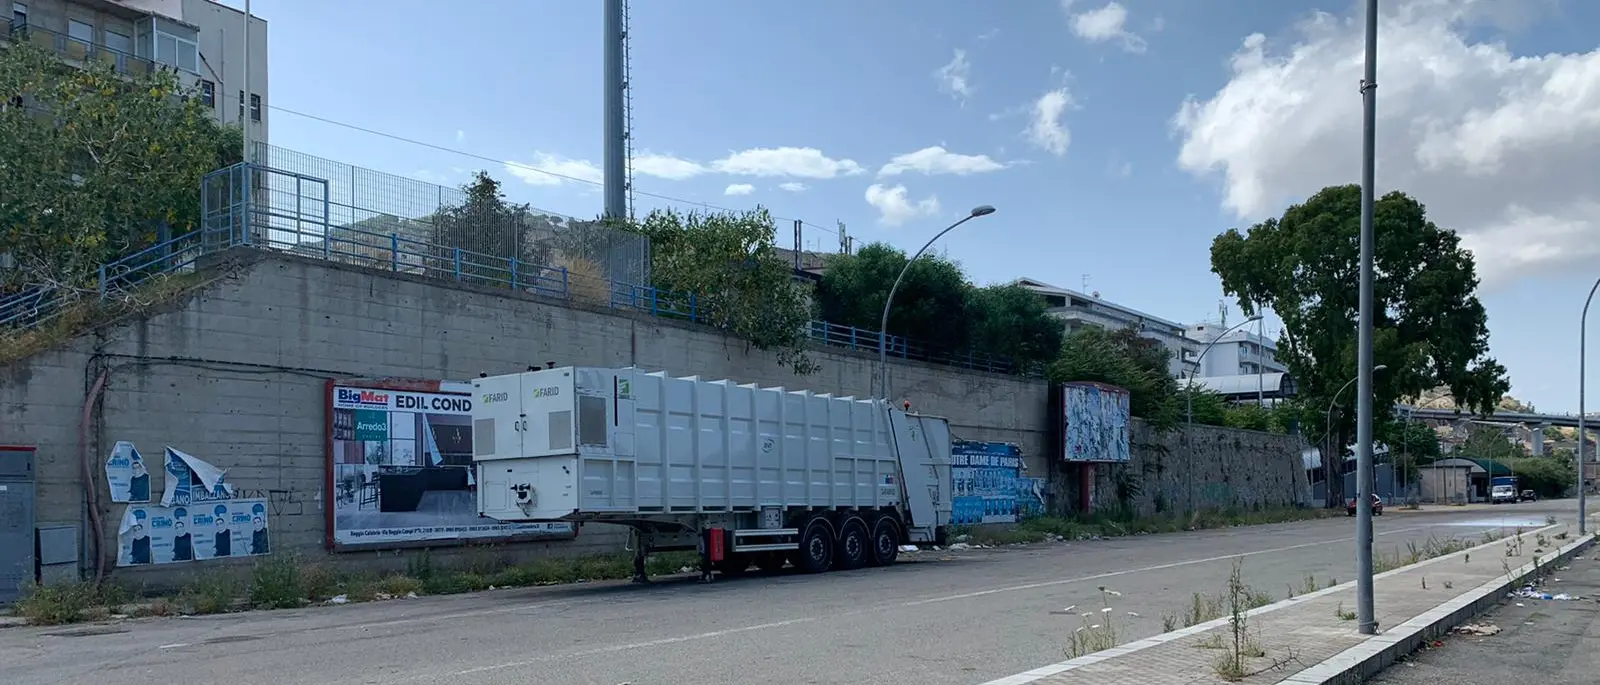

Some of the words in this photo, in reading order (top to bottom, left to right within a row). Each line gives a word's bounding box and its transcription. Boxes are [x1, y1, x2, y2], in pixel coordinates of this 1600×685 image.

[338, 389, 389, 402] BigMat
[488, 392, 509, 403] FARID
[539, 386, 560, 397] FARID
[395, 395, 428, 409] EDIL
[356, 421, 387, 432] Arredo3
[952, 454, 969, 466] OTRE
[970, 454, 989, 466] DAME
[990, 455, 999, 467] DE
[1000, 456, 1019, 468] PARIS
